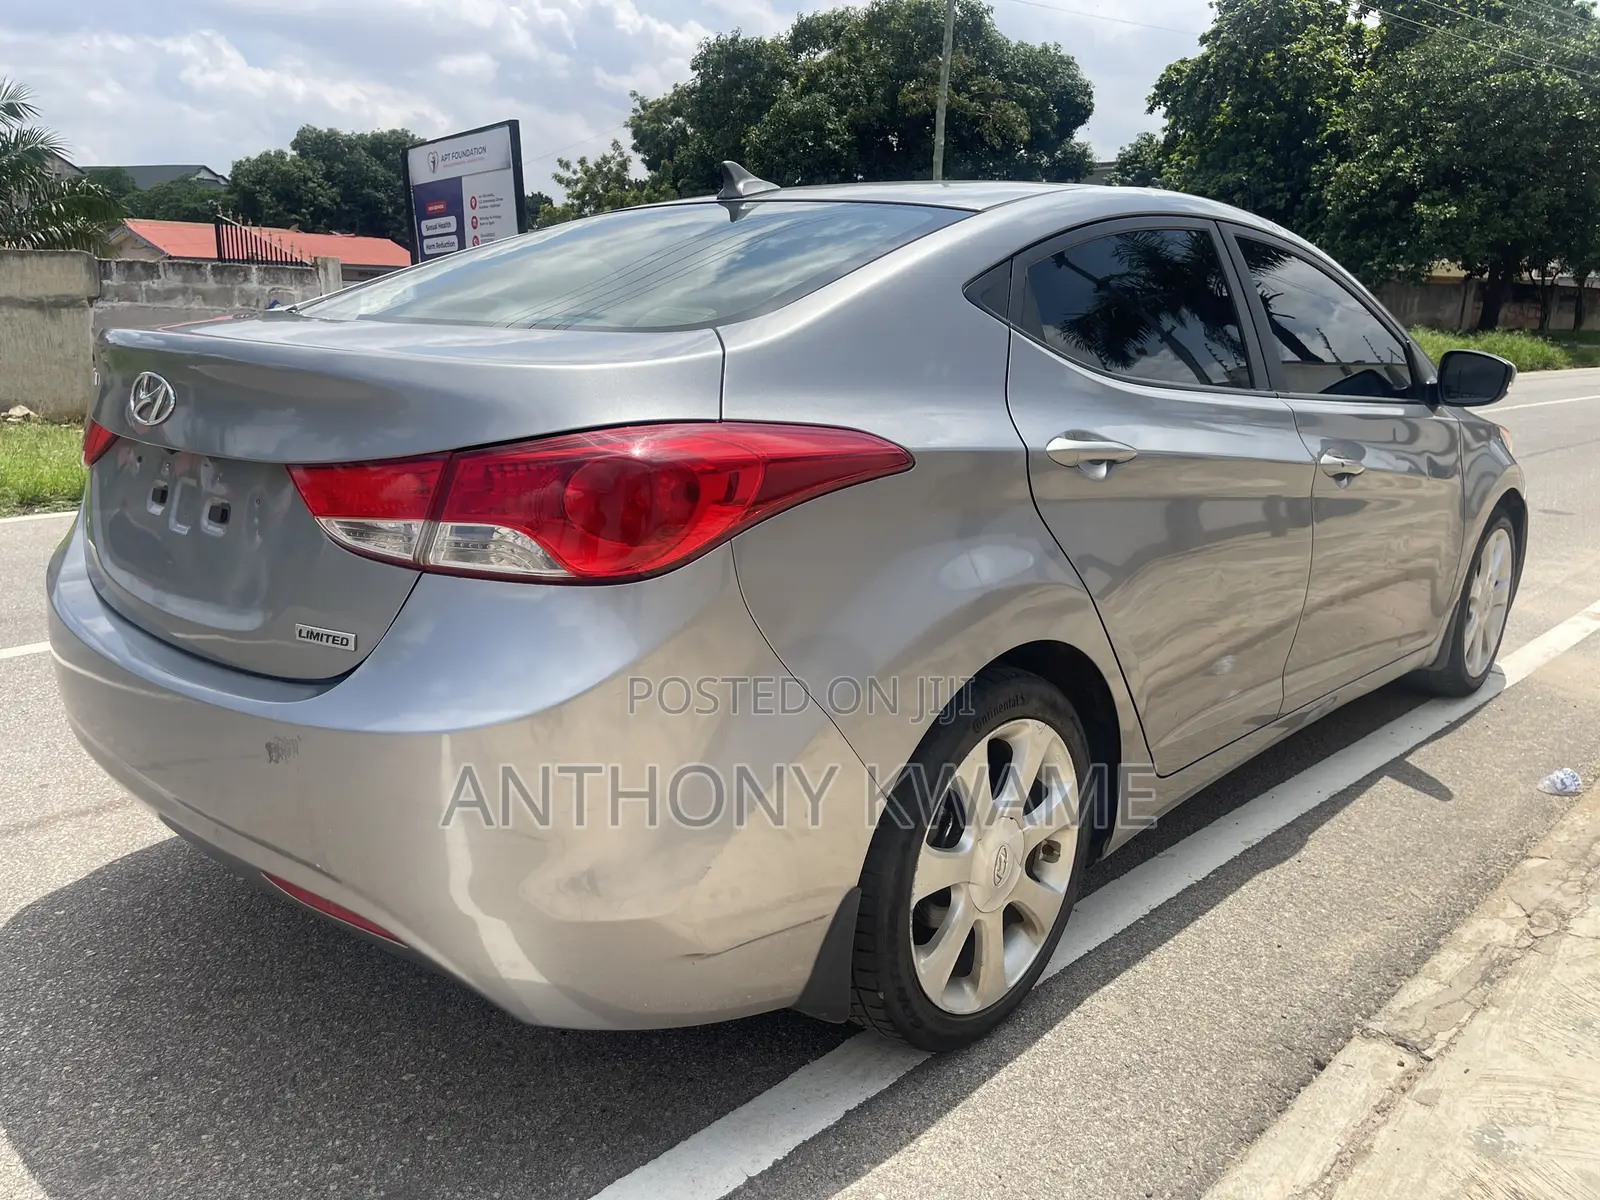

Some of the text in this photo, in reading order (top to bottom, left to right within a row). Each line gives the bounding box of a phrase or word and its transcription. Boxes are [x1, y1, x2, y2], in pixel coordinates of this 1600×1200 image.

[441, 152, 451, 163] APT
[452, 146, 487, 160] FOUNDATION
[435, 241, 456, 249] Reduction
[298, 628, 350, 647] LIMITED
[972, 694, 1022, 734] Continental
